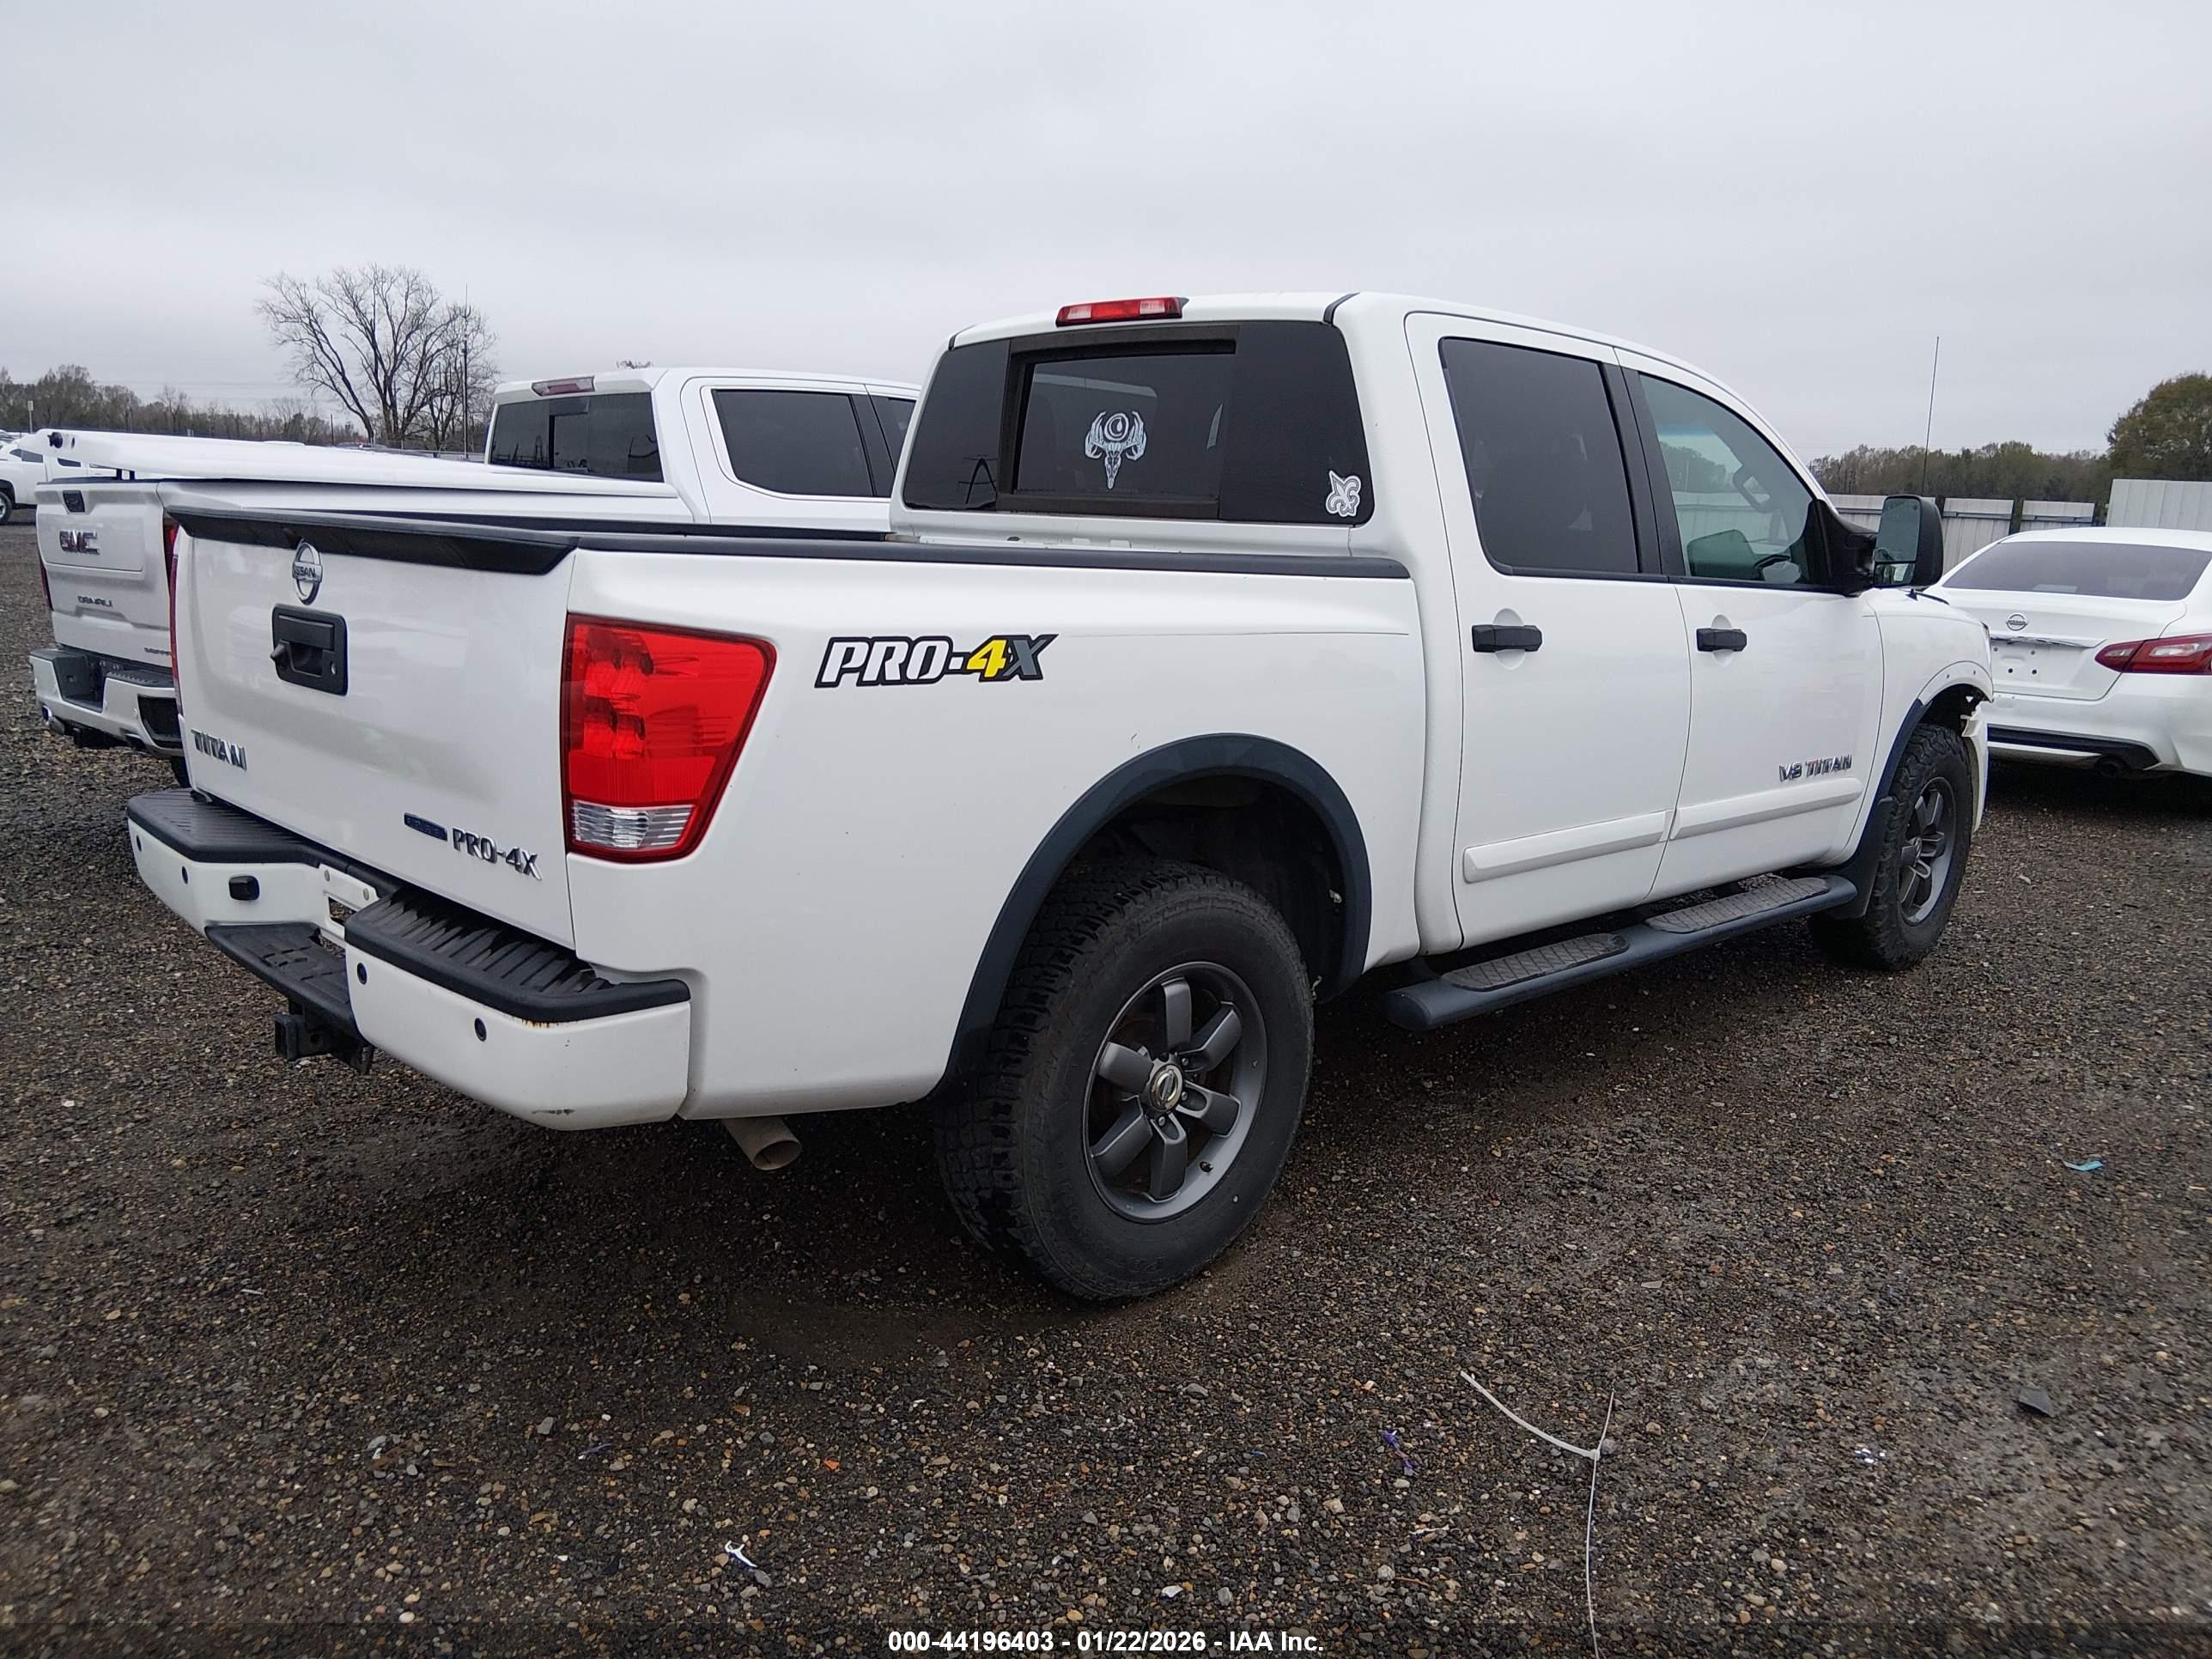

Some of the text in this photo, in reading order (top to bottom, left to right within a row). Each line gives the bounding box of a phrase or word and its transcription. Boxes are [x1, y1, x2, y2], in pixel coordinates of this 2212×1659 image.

[59, 529, 100, 556] GMC
[814, 634, 1059, 689] PRO-4X
[191, 728, 247, 771] TITAN
[1778, 754, 1852, 782] V8 TITAN
[453, 827, 543, 880] PRO-4X
